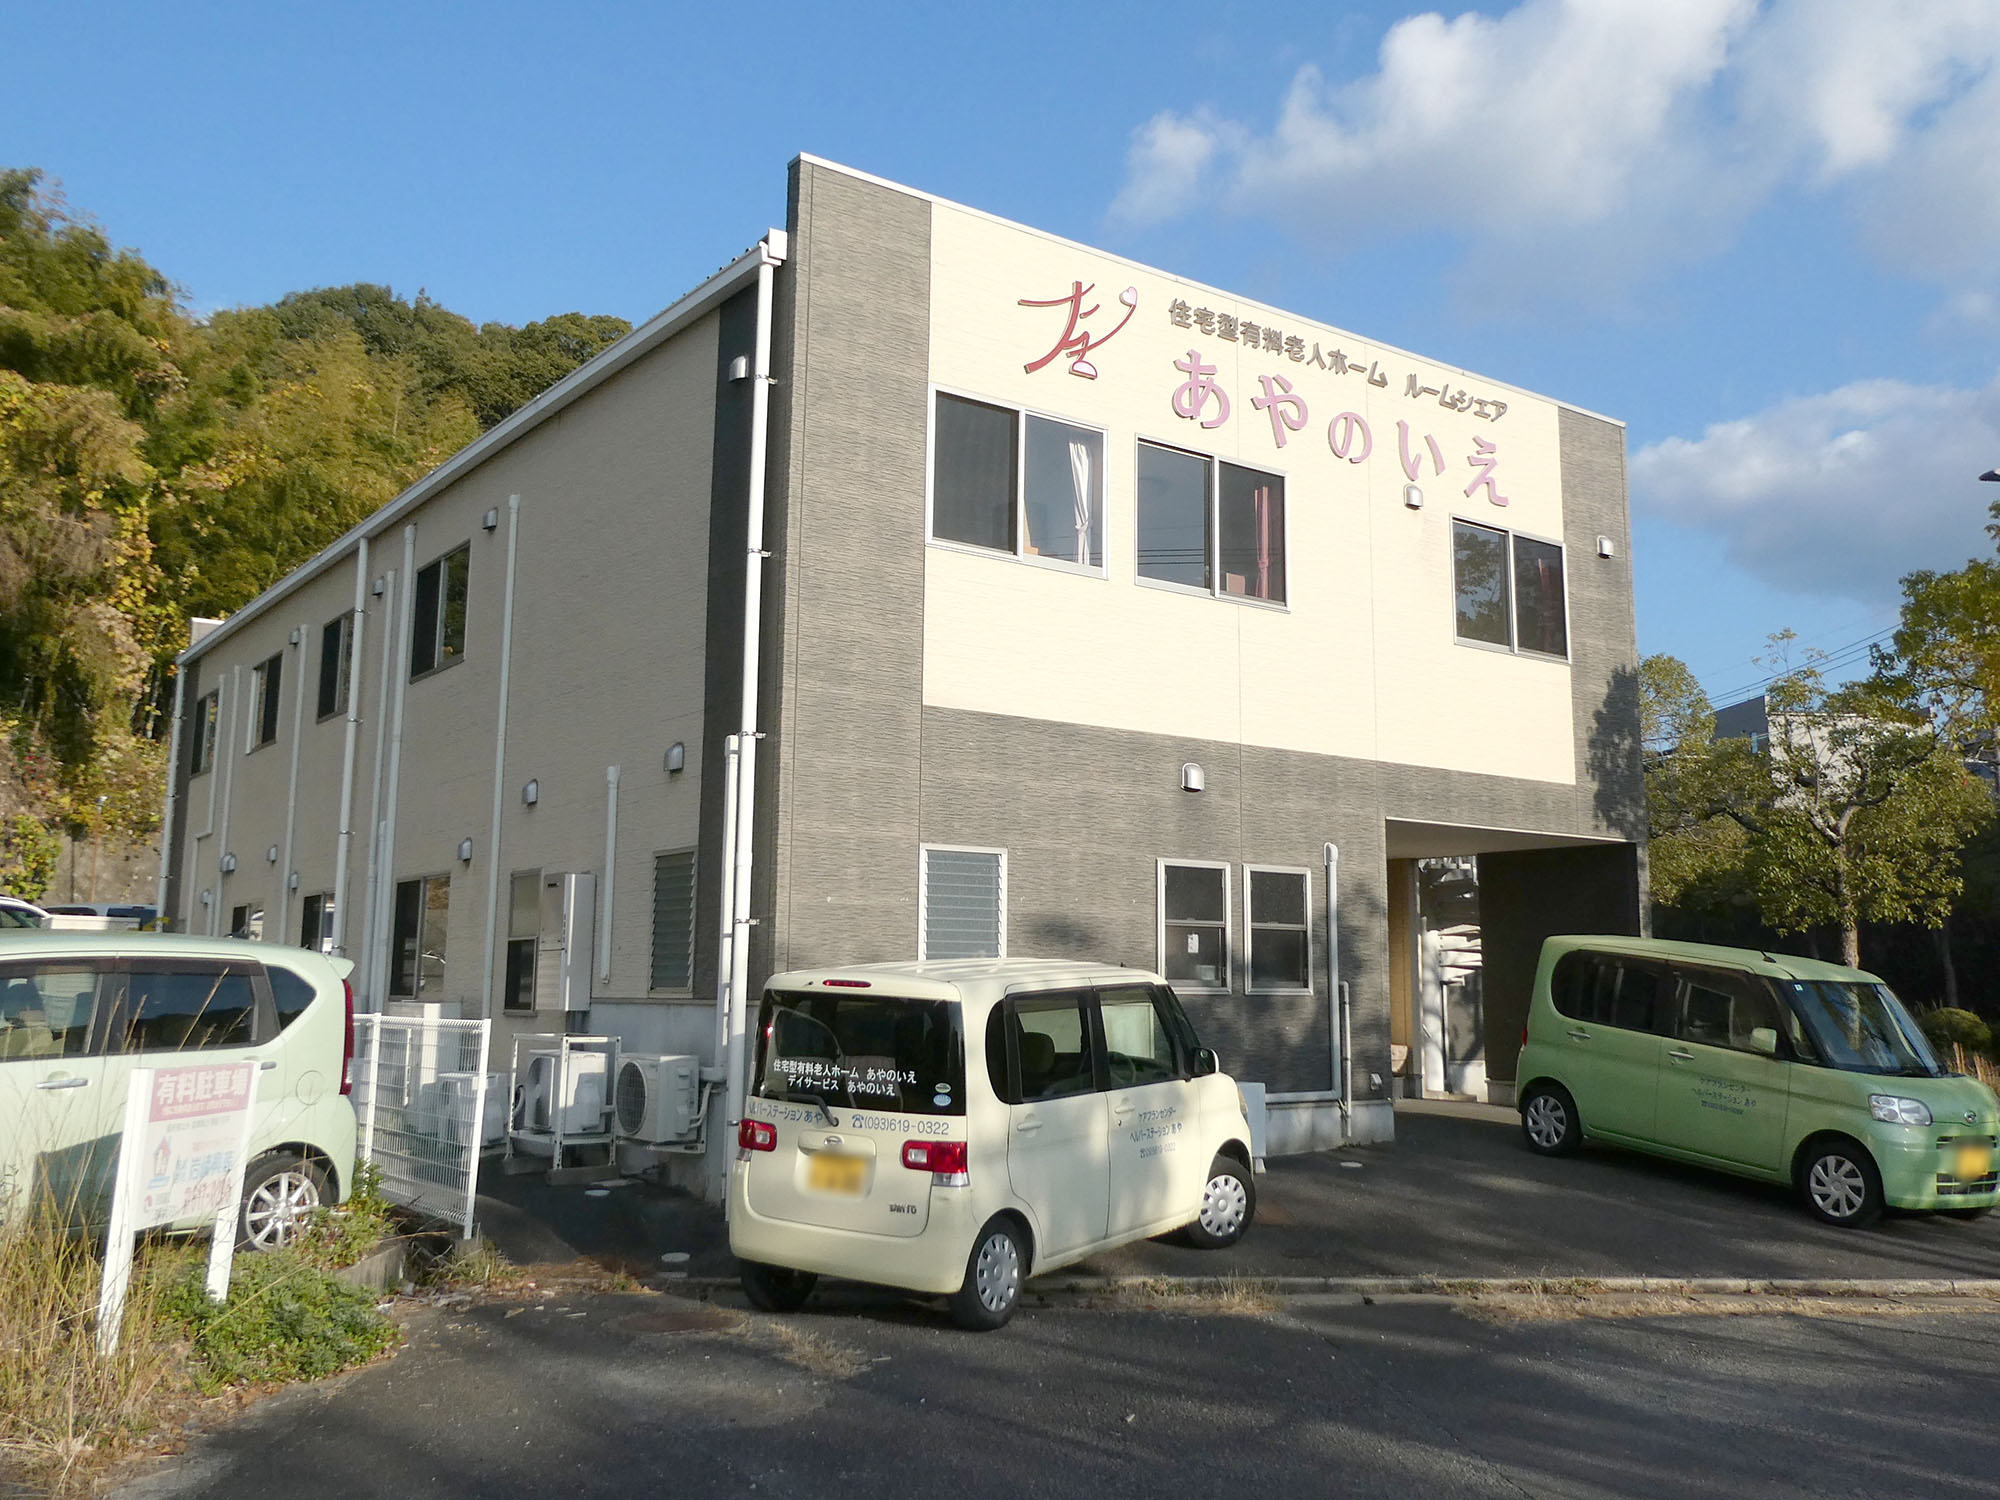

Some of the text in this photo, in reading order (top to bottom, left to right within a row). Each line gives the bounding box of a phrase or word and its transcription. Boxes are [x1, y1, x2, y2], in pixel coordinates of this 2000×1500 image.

[1168, 298, 1388, 388] 住宅型有料老人ホーム
[1172, 349, 1510, 507] あやのいえ
[157, 1068, 249, 1105] 有料駐車場
[773, 1059, 917, 1084] 住宅型有料老人ホーム あやのいえ
[788, 1074, 896, 1096] デイサービス あやのいえ
[864, 1115, 950, 1135] (093)619-0322
